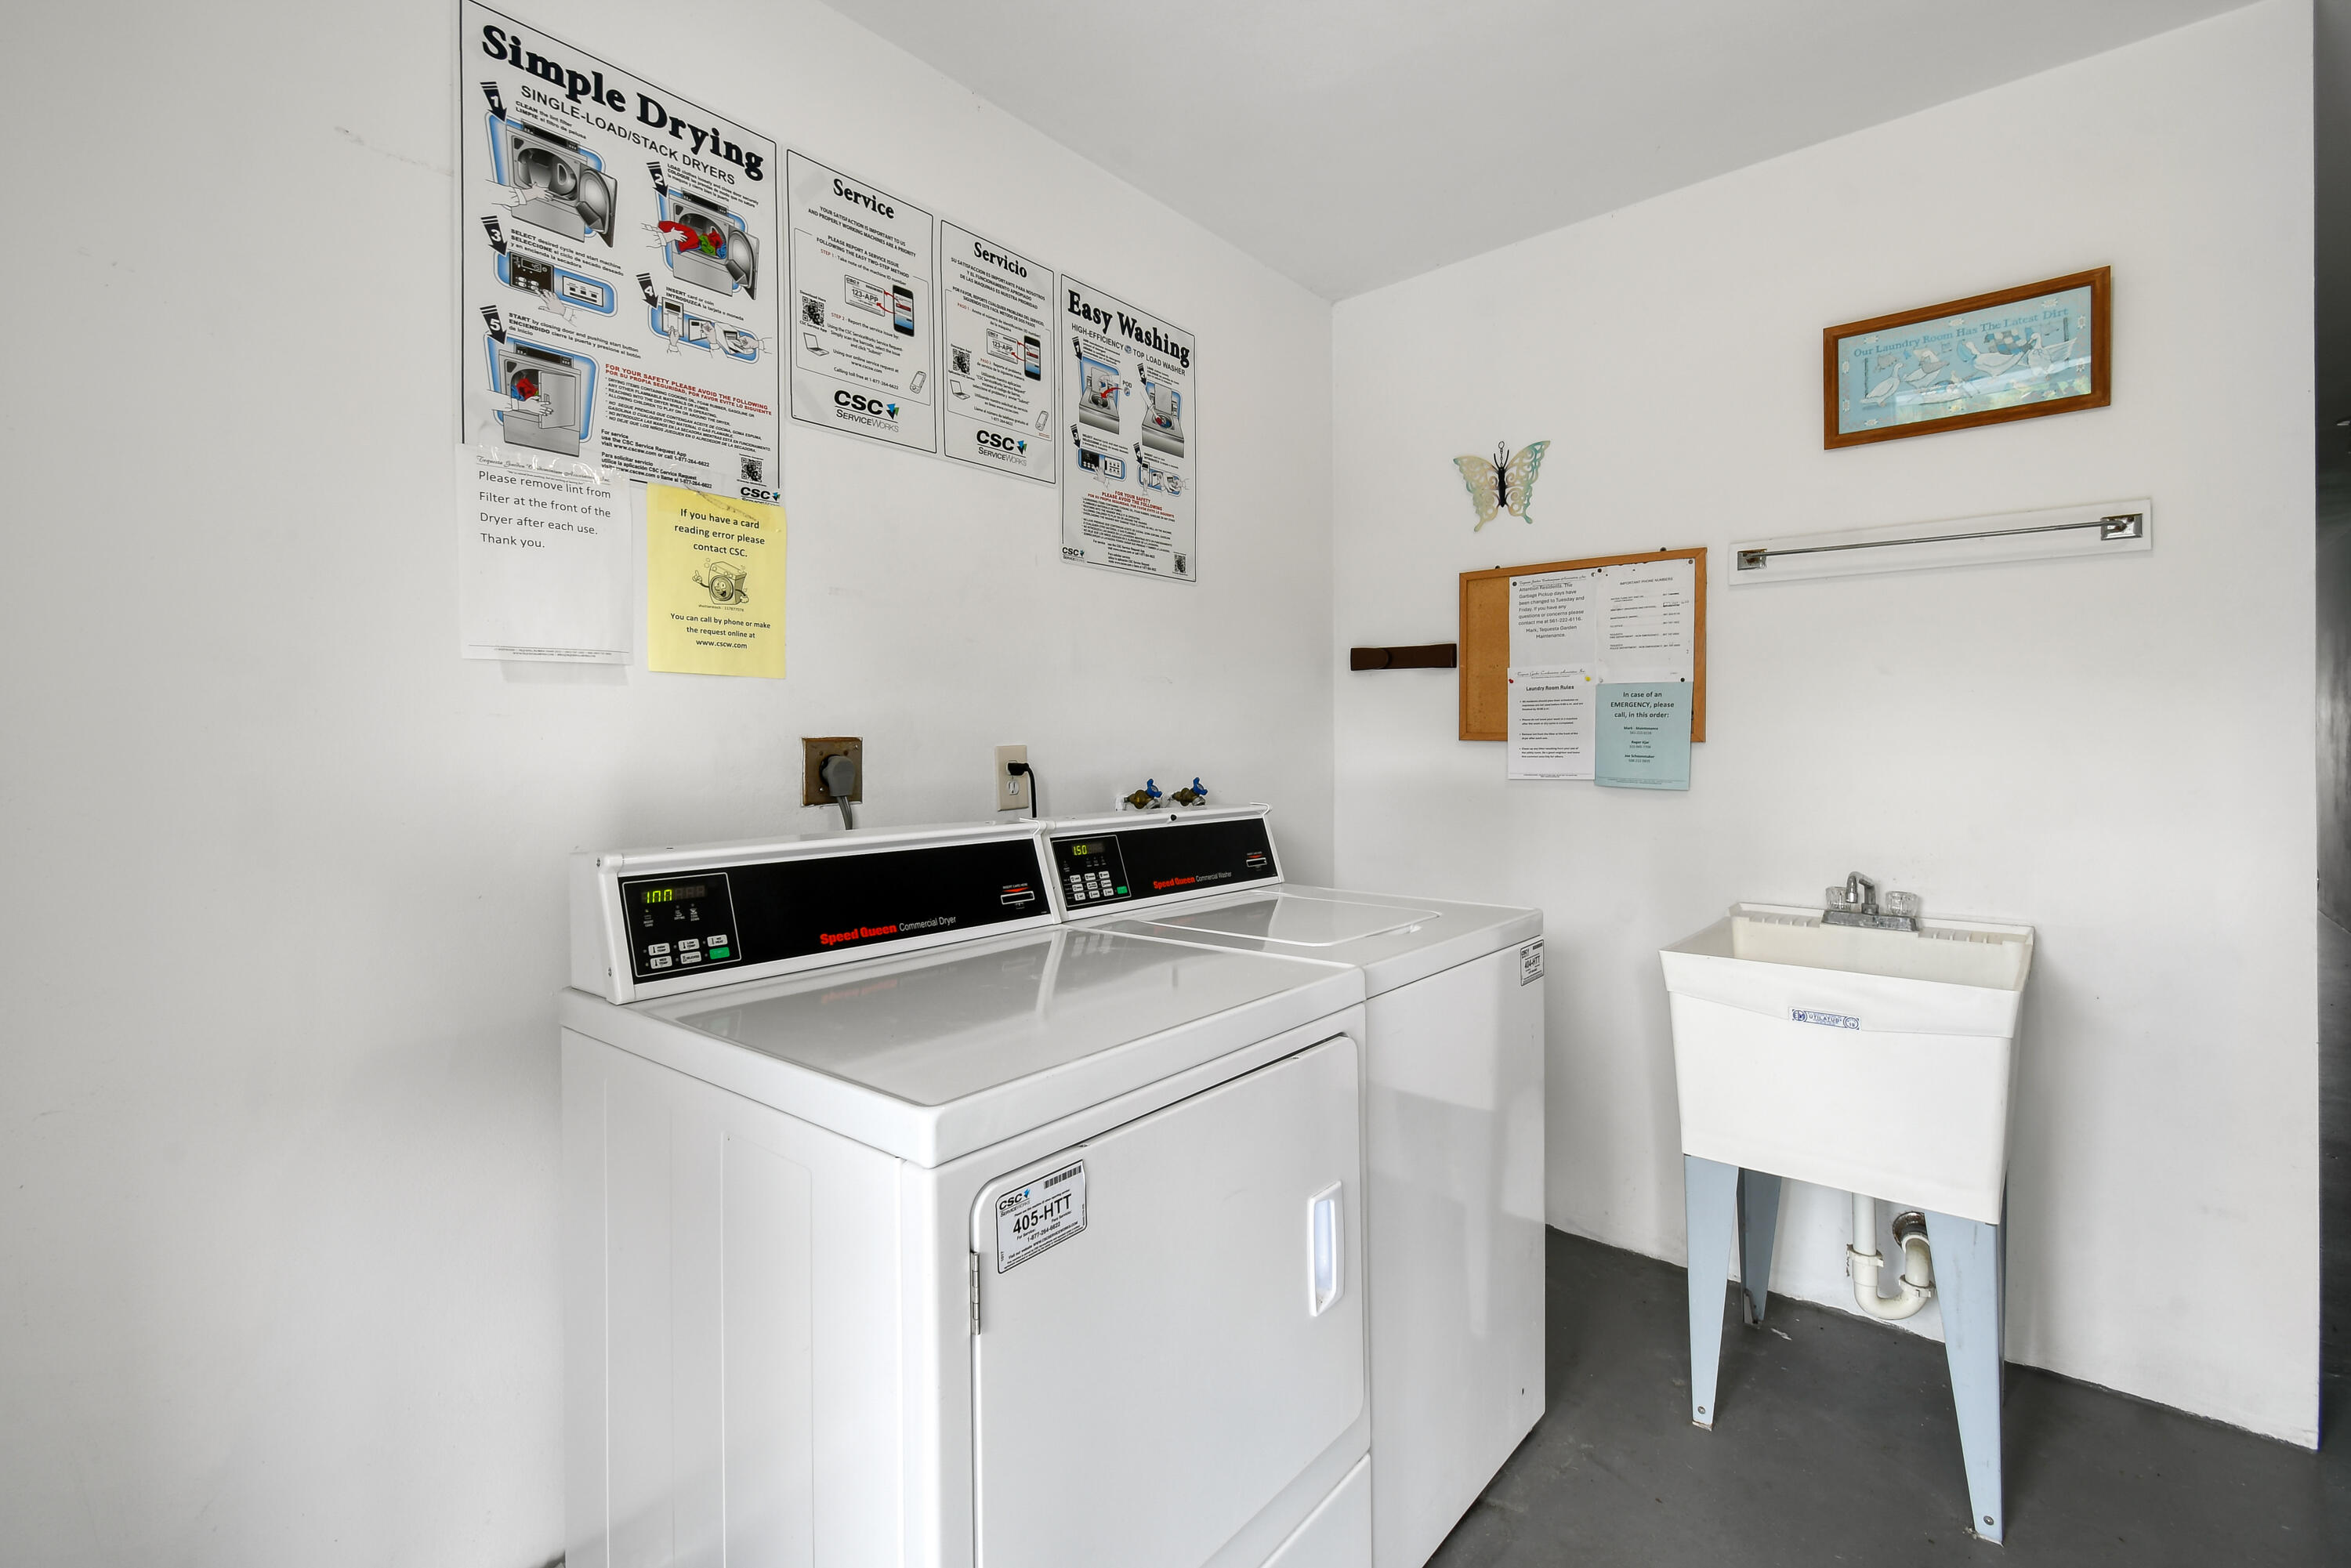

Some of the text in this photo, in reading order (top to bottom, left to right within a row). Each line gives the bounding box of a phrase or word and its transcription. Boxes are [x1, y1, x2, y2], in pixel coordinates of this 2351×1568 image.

[482, 25, 764, 181] Simple Drying
[491, 96, 499, 107] 1
[521, 85, 735, 185] SINGLE-LOAD/STACK DRYERS
[654, 173, 664, 186] 2
[833, 179, 894, 219] Service
[491, 230, 502, 242] 3
[511, 229, 537, 241] SELECT
[538, 238, 559, 248] desired
[600, 259, 621, 270] machine
[974, 242, 1027, 278] Servicio
[644, 287, 654, 296] 4
[666, 286, 686, 296] INSERT
[852, 288, 878, 302] 123-APP
[490, 319, 501, 331] 5
[1068, 289, 1113, 334] Easy
[1117, 311, 1190, 368] Washing
[1853, 308, 2069, 359] Our Laundry Room Has The Latest Dirt
[992, 340, 1013, 352] 123-APP
[1072, 323, 1124, 350] HIGH-EFFICIENCY
[1132, 349, 1145, 358] TOP
[1146, 354, 1161, 366] LOAD
[1162, 360, 1186, 376] WASHER
[621, 368, 642, 378] YOUR
[643, 374, 669, 384] SAFETY
[671, 381, 696, 392] PLEASE
[697, 388, 717, 397] AVOID
[733, 397, 768, 410] FOLLOWING
[1122, 380, 1132, 389] POD
[834, 390, 883, 415] CSC
[976, 429, 1015, 451] CSC
[479, 470, 516, 484] Please
[520, 479, 563, 491] remove
[566, 483, 584, 494] lint
[586, 486, 610, 498] from
[740, 487, 770, 500] CSC
[480, 491, 510, 504] Filter
[528, 498, 547, 509] the
[550, 500, 578, 512] front
[581, 505, 592, 514] of
[594, 507, 610, 518] the
[480, 512, 597, 534] Dryer after each use.
[681, 509, 687, 517] If
[690, 512, 706, 520] you
[709, 513, 730, 524] have
[741, 519, 759, 529] card
[480, 533, 545, 548] Thank you.
[675, 525, 765, 545] reading error please
[694, 544, 748, 557] contact CSC.
[1062, 547, 1079, 556] CSC
[714, 617, 723, 625] by
[696, 640, 748, 649] www.cscw.com
[1153, 878, 1175, 889] Speed
[1196, 874, 1218, 882] Commercial
[820, 917, 956, 945] Speed Queen Commercial Dryer
[999, 1193, 1022, 1211] CSC
[1012, 1193, 1072, 1234] 405-HTT
[1027, 1222, 1060, 1242] 1-877-264-6622
